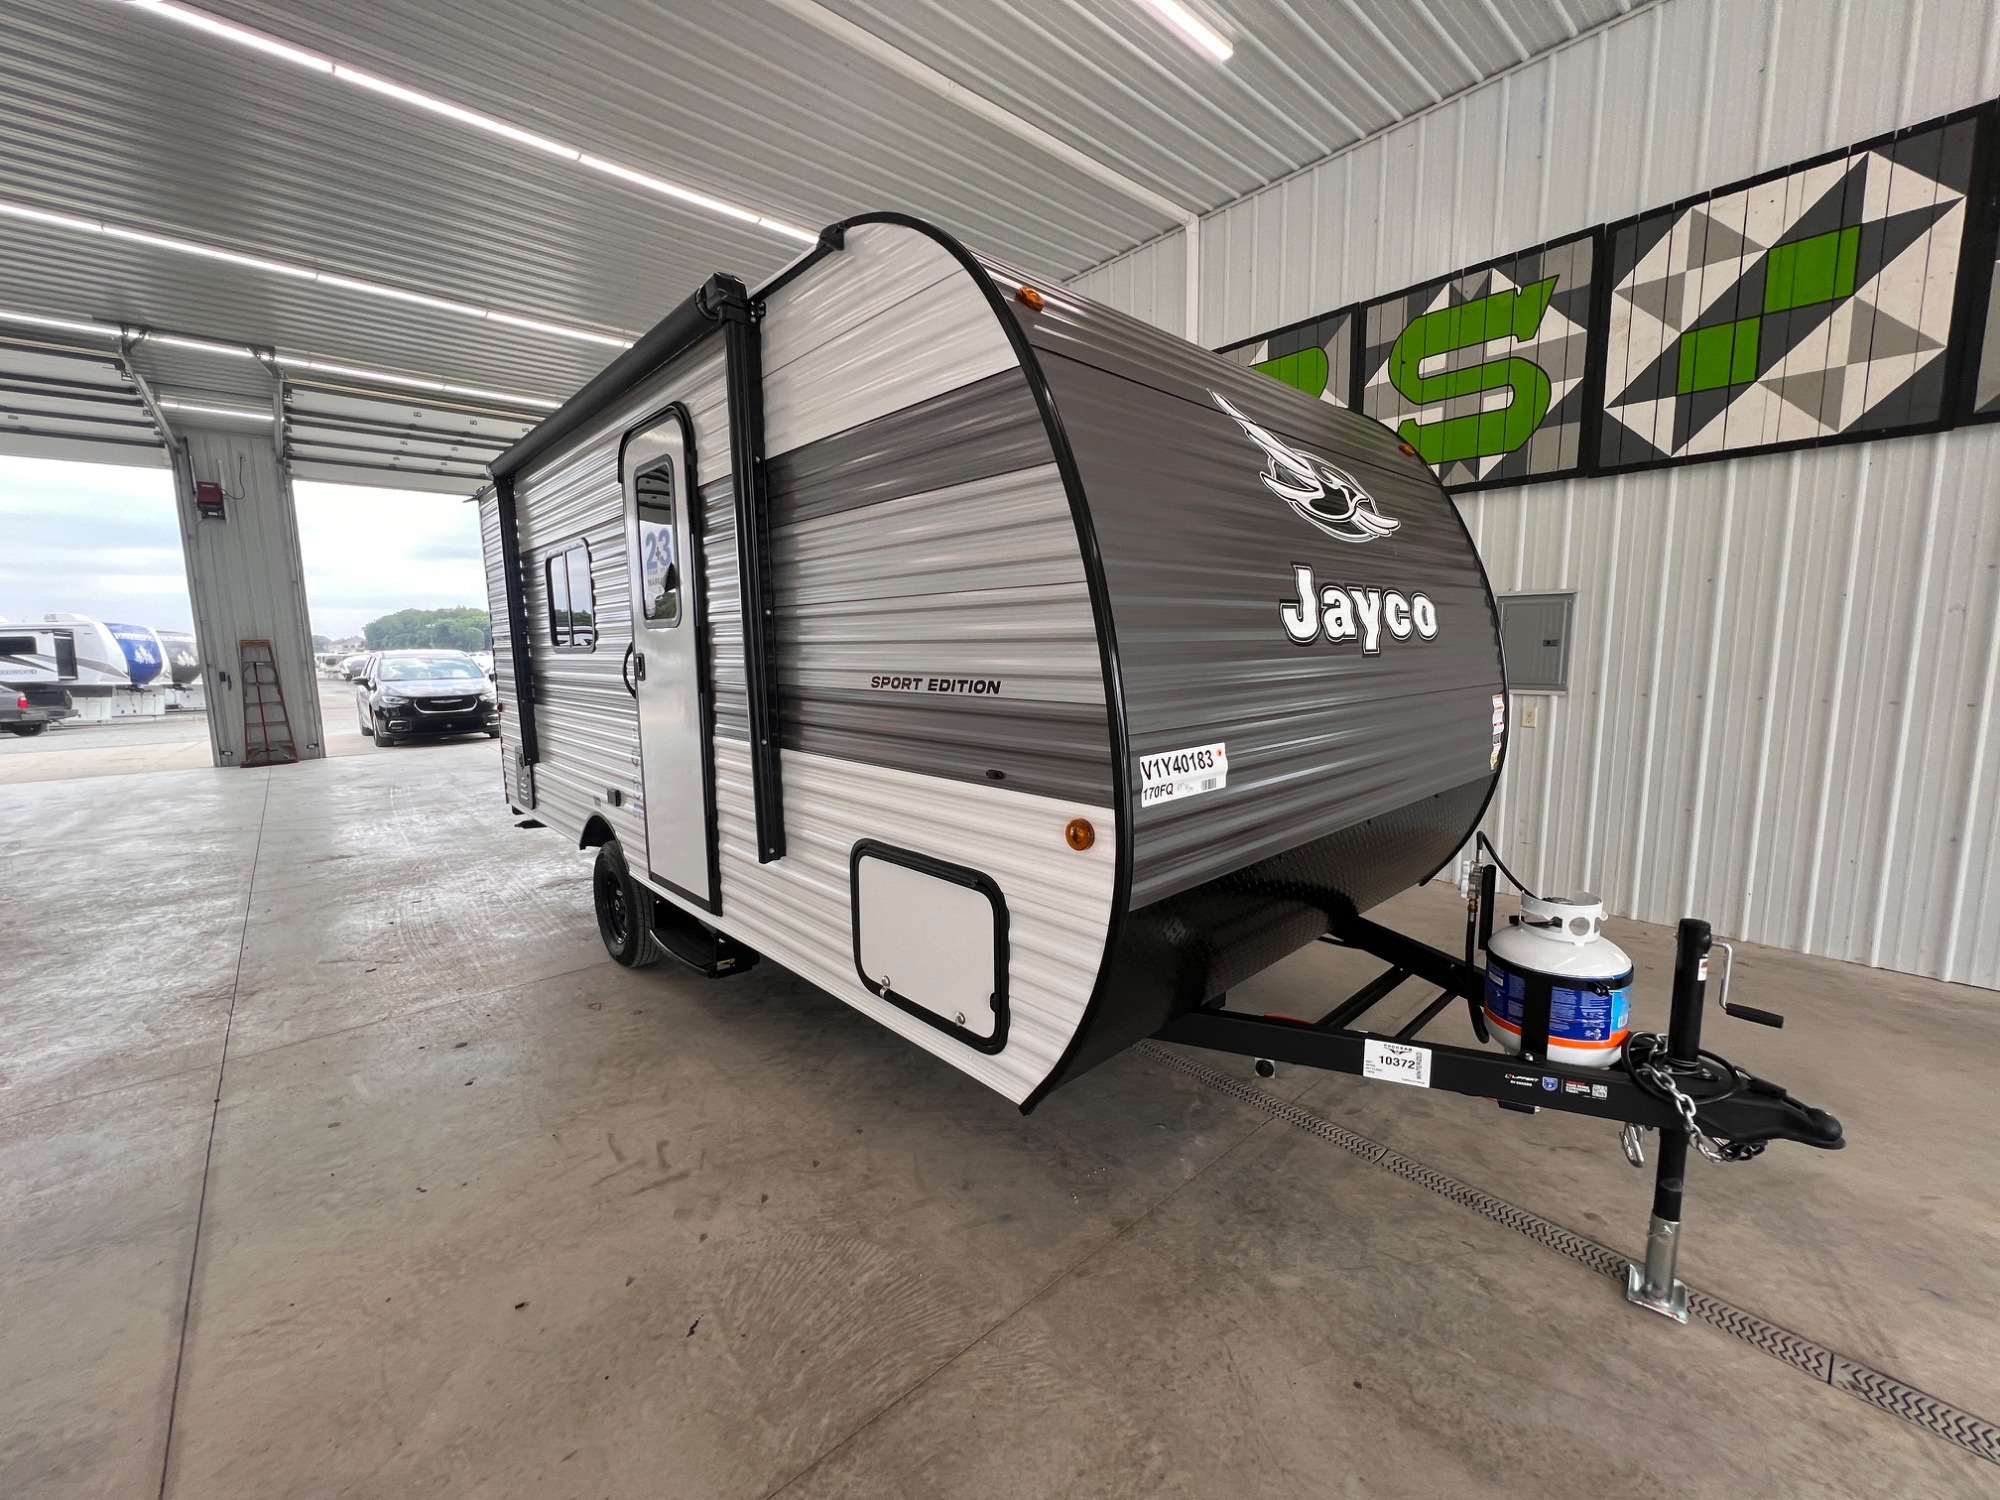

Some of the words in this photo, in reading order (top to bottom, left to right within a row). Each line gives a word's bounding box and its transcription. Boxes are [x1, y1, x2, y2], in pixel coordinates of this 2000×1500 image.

[1279, 561, 1439, 657] Jayco
[871, 676, 923, 690] SPORT
[927, 678, 1002, 694] EDITION
[1141, 750, 1214, 780] V1Y40183
[1143, 782, 1174, 801] 170FQ
[1379, 1055, 1416, 1070] 10372
